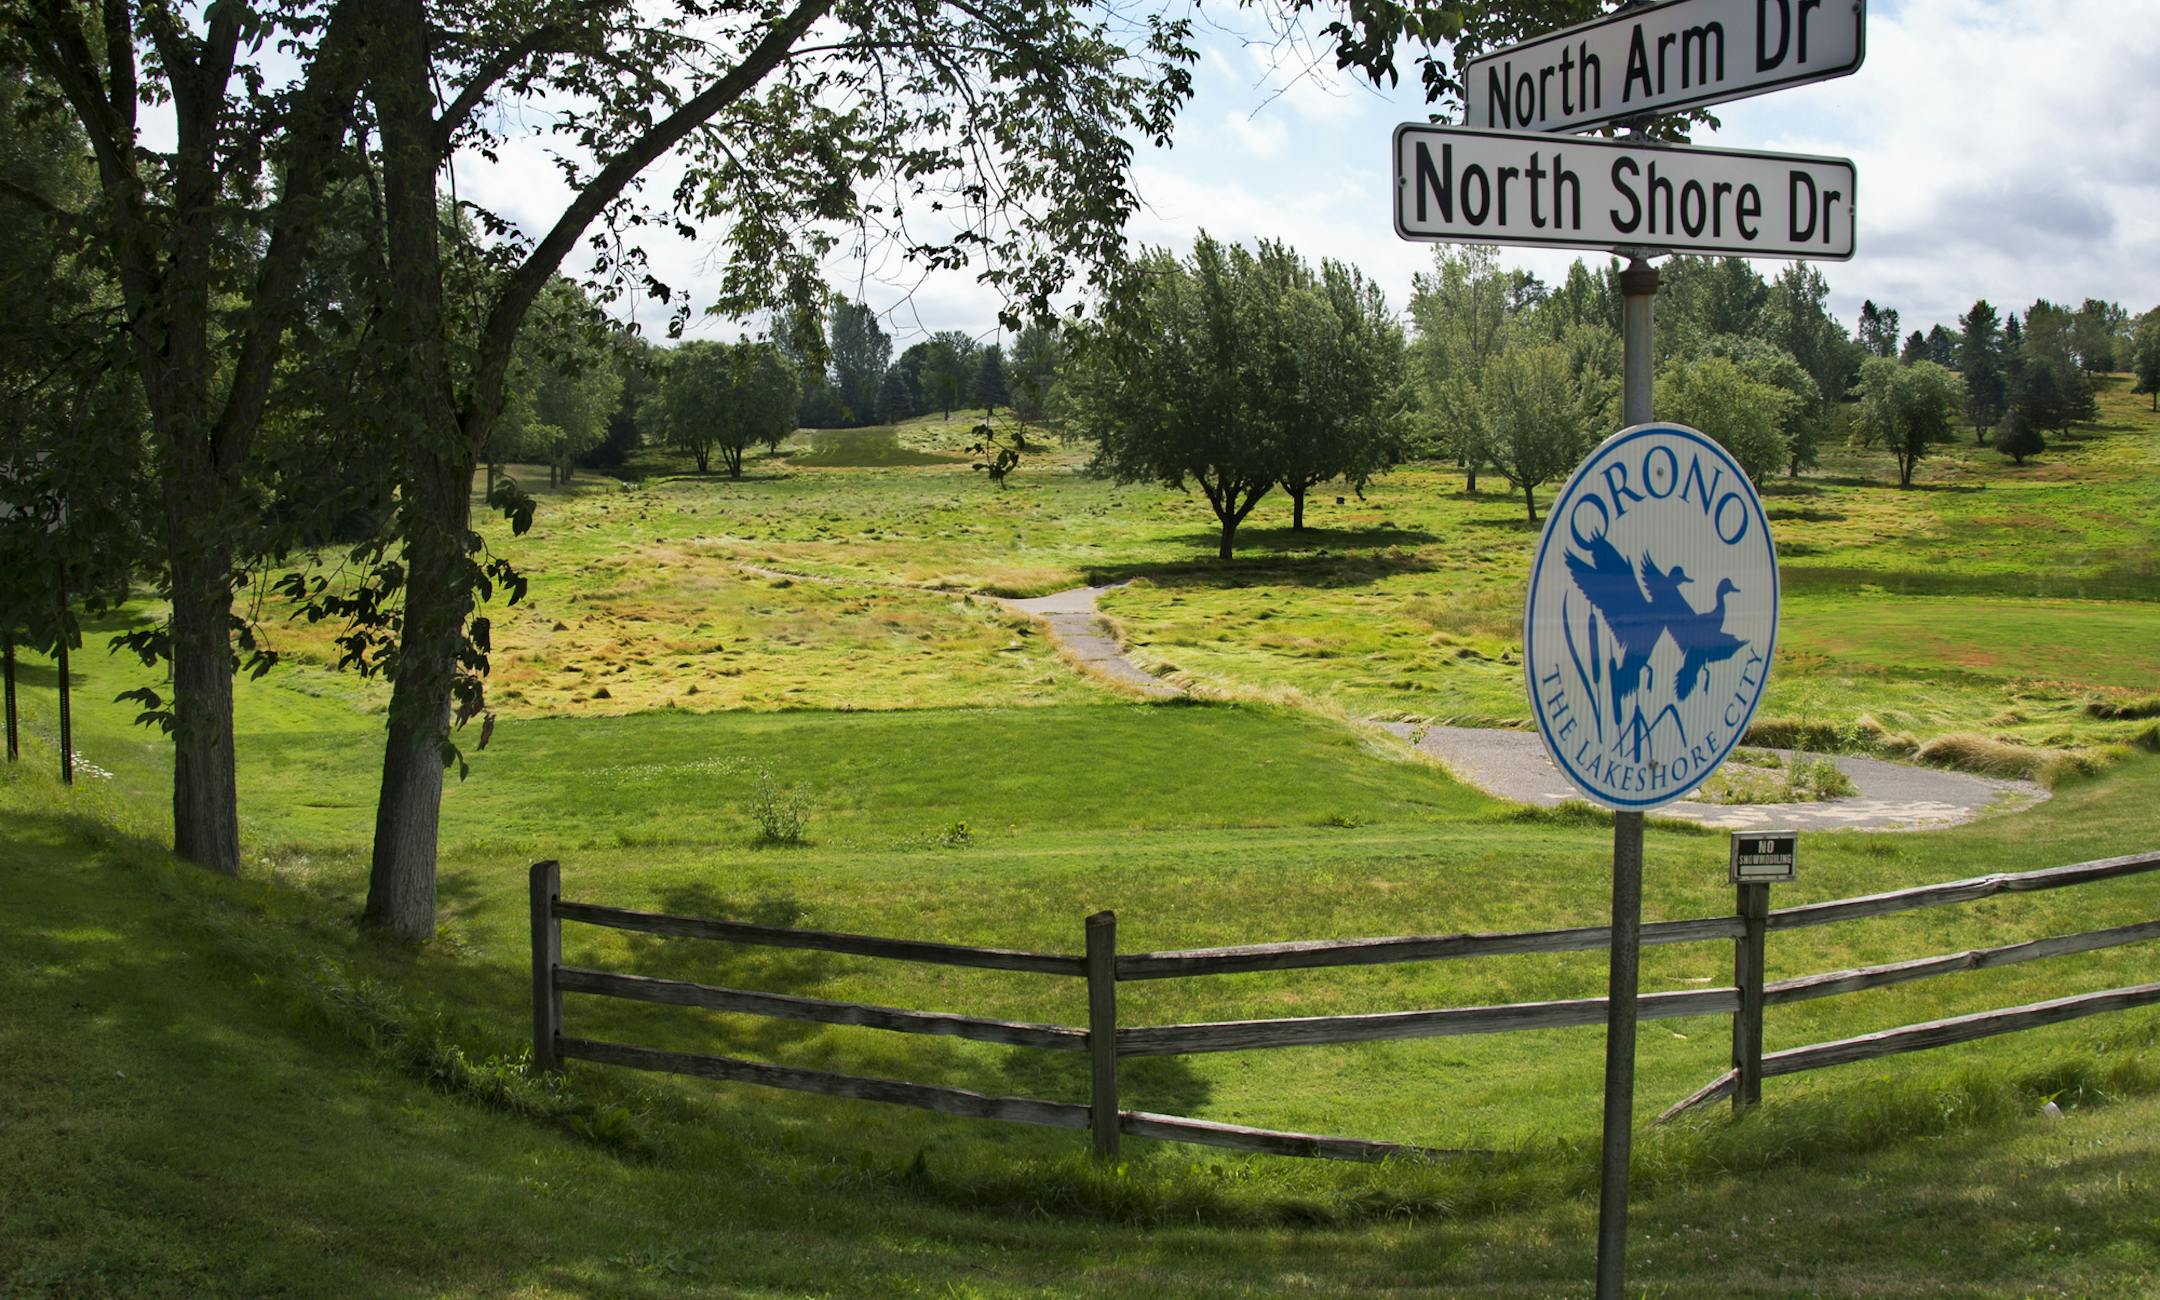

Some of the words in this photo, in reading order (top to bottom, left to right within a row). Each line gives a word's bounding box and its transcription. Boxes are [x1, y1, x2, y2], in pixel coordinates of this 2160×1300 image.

[1489, 40, 1600, 129] North
[1622, 20, 1724, 103] Arm
[1756, 0, 1821, 73] Dr
[1416, 142, 1581, 230] North
[1610, 156, 1761, 241] Shore
[1789, 170, 1841, 244] Dr
[1570, 446, 1748, 550] ORONO
[1543, 664, 1578, 741] THE
[1576, 732, 1719, 792] LAKESHORE
[1724, 648, 1762, 727] CITY
[1758, 840, 1775, 854] NO
